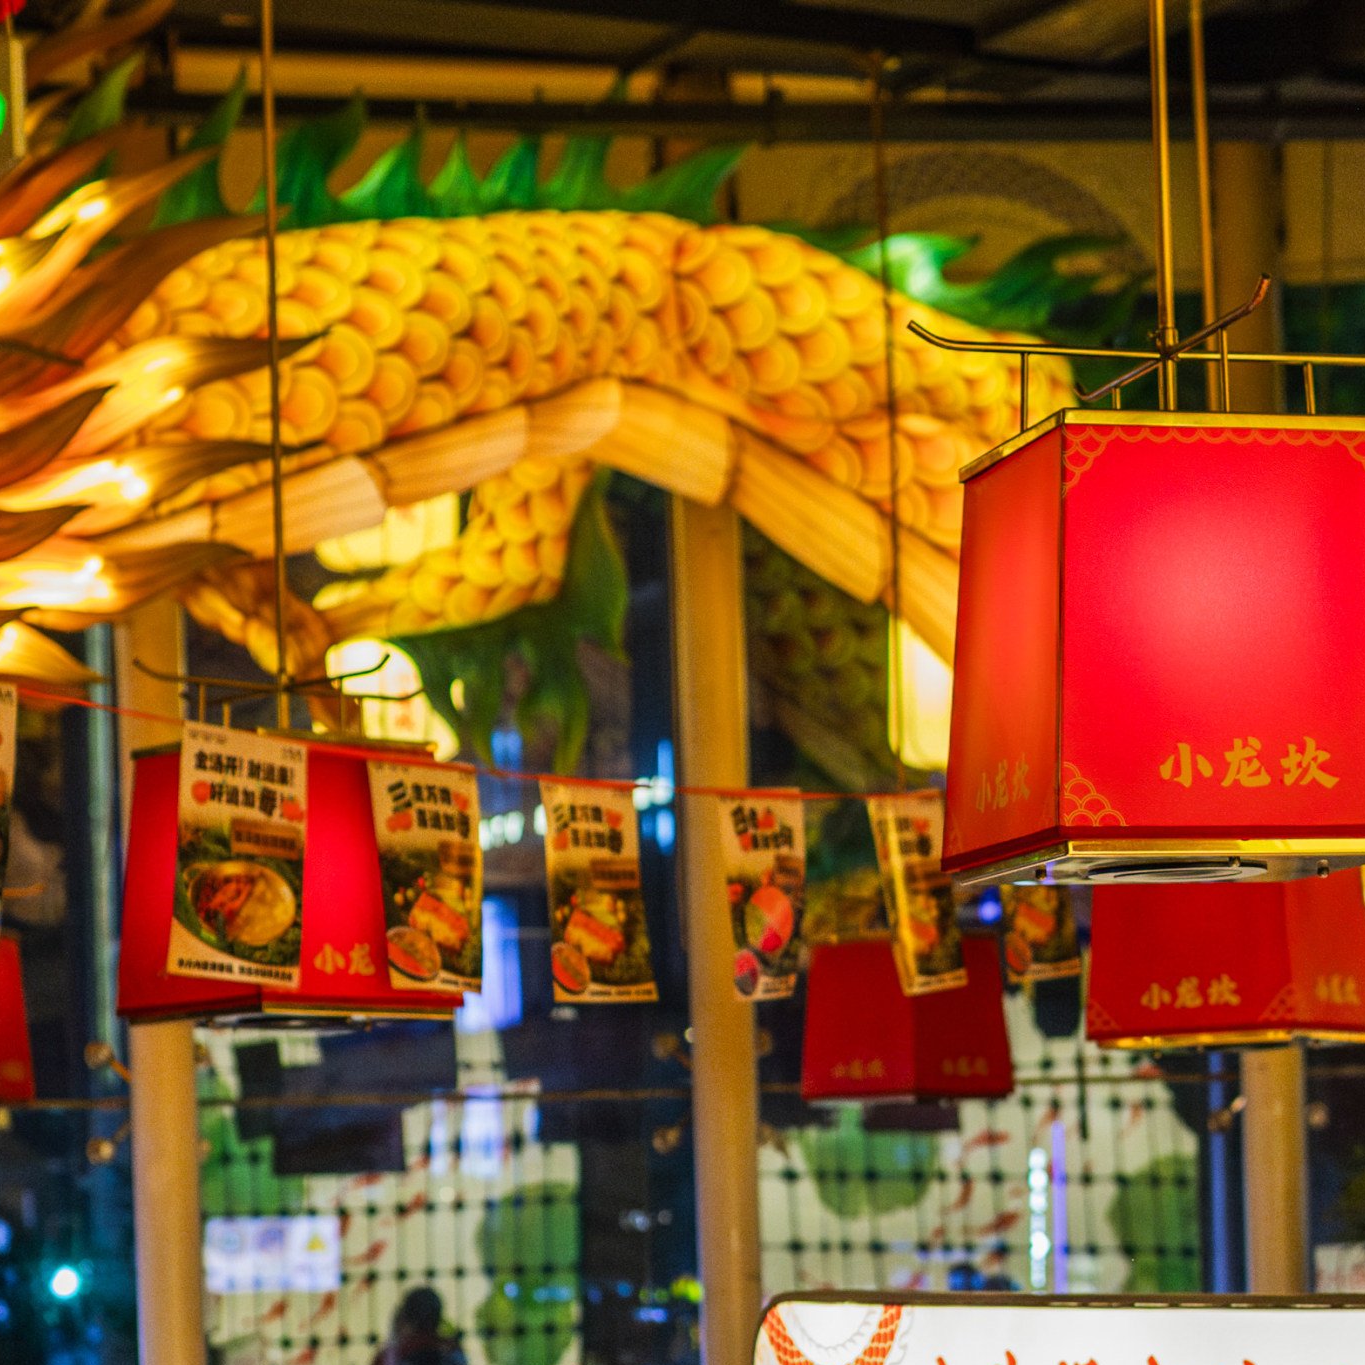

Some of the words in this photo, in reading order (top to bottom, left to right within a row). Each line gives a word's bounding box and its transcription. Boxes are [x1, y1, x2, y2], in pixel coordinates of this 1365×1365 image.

[975, 756, 1031, 814] 小龙坎
[1160, 736, 1341, 790] 小龙坎
[313, 943, 377, 977] 小龙
[1140, 973, 1242, 1011] 小龙坎
